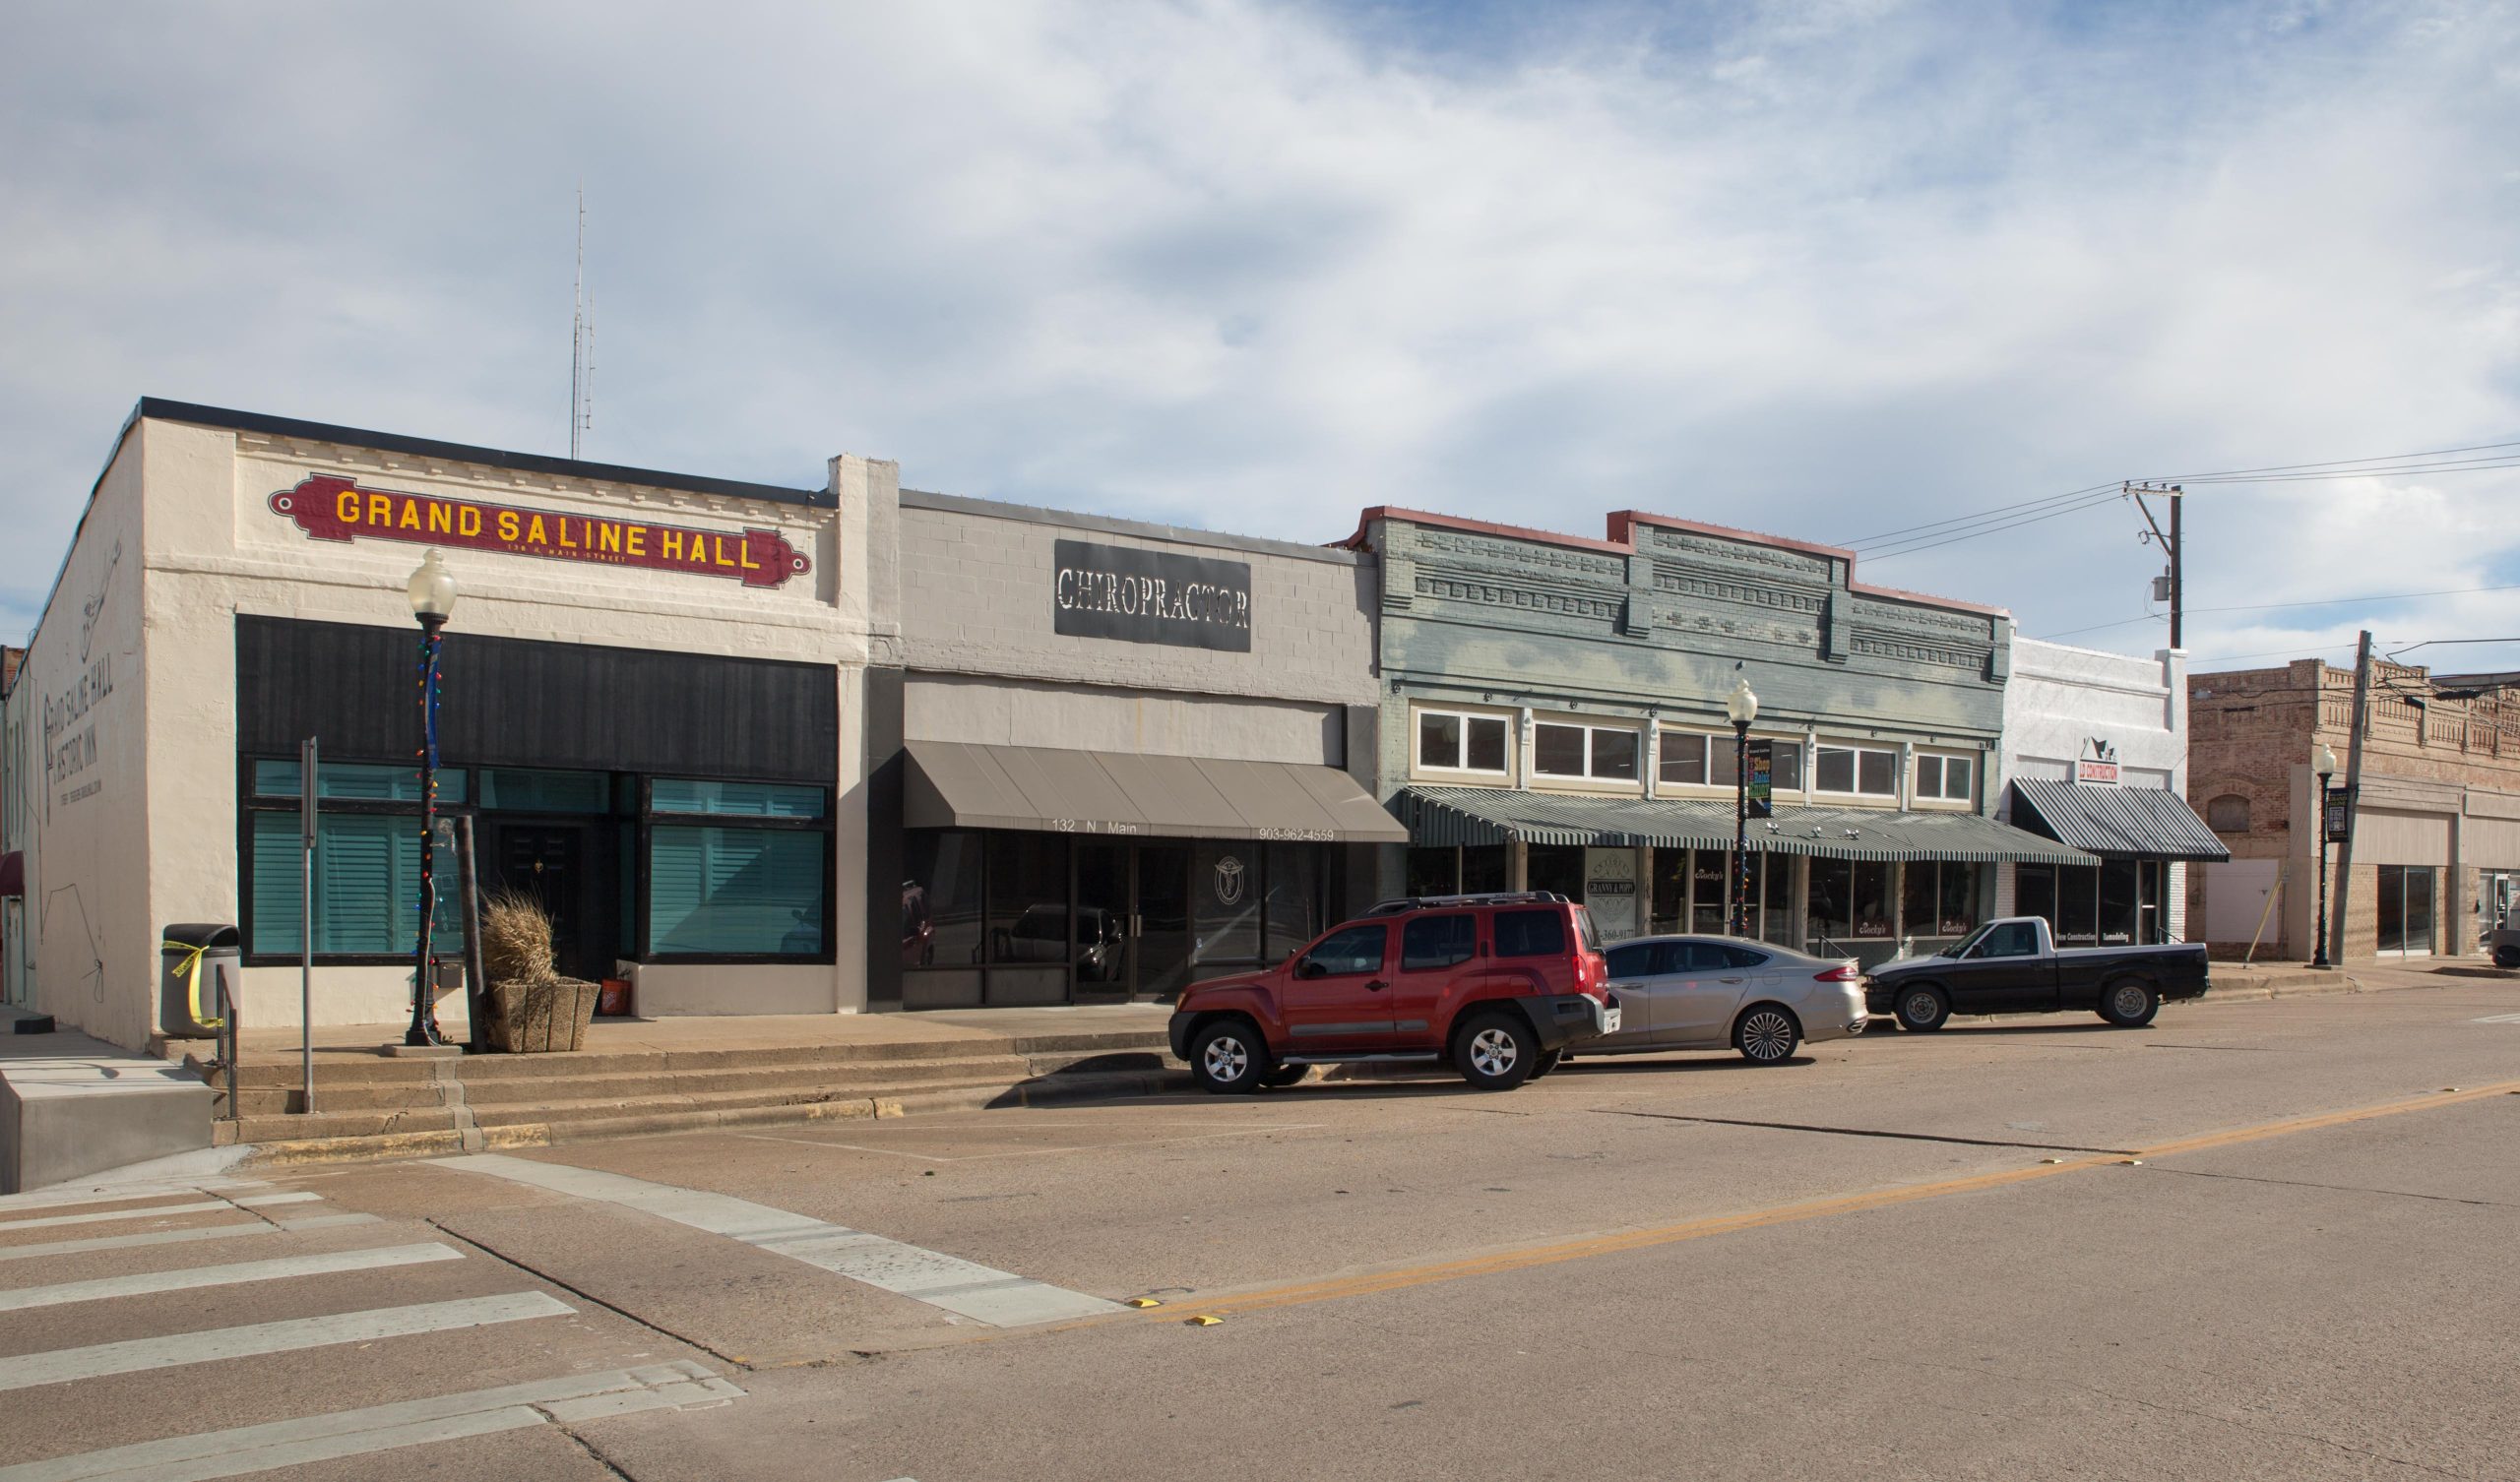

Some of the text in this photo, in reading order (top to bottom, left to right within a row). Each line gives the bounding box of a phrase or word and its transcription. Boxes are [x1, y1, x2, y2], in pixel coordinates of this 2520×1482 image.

[337, 491, 761, 570] GRAND SALINE HALL
[549, 549, 577, 558] MAIN
[586, 551, 626, 563] STREET
[1057, 569, 1248, 629] CHIROPRACTOR
[66, 674, 90, 727] SALINE
[91, 652, 113, 707] HALL
[85, 722, 97, 768] INN
[1754, 757, 1770, 772] Shop
[2087, 764, 2117, 780] CONSTRUCTION
[1052, 819, 1137, 834] 132 N Main
[1259, 828, 1334, 841] 903-962-4559
[1695, 868, 1724, 882] Rocky's
[1588, 883, 1612, 894] GRANNY
[1613, 883, 1618, 894] &
[1859, 922, 1886, 936] Rocky's
[1942, 920, 1967, 935] Rocky's
[2067, 932, 2096, 941] Construction
[2103, 932, 2129, 943] Remodeling
